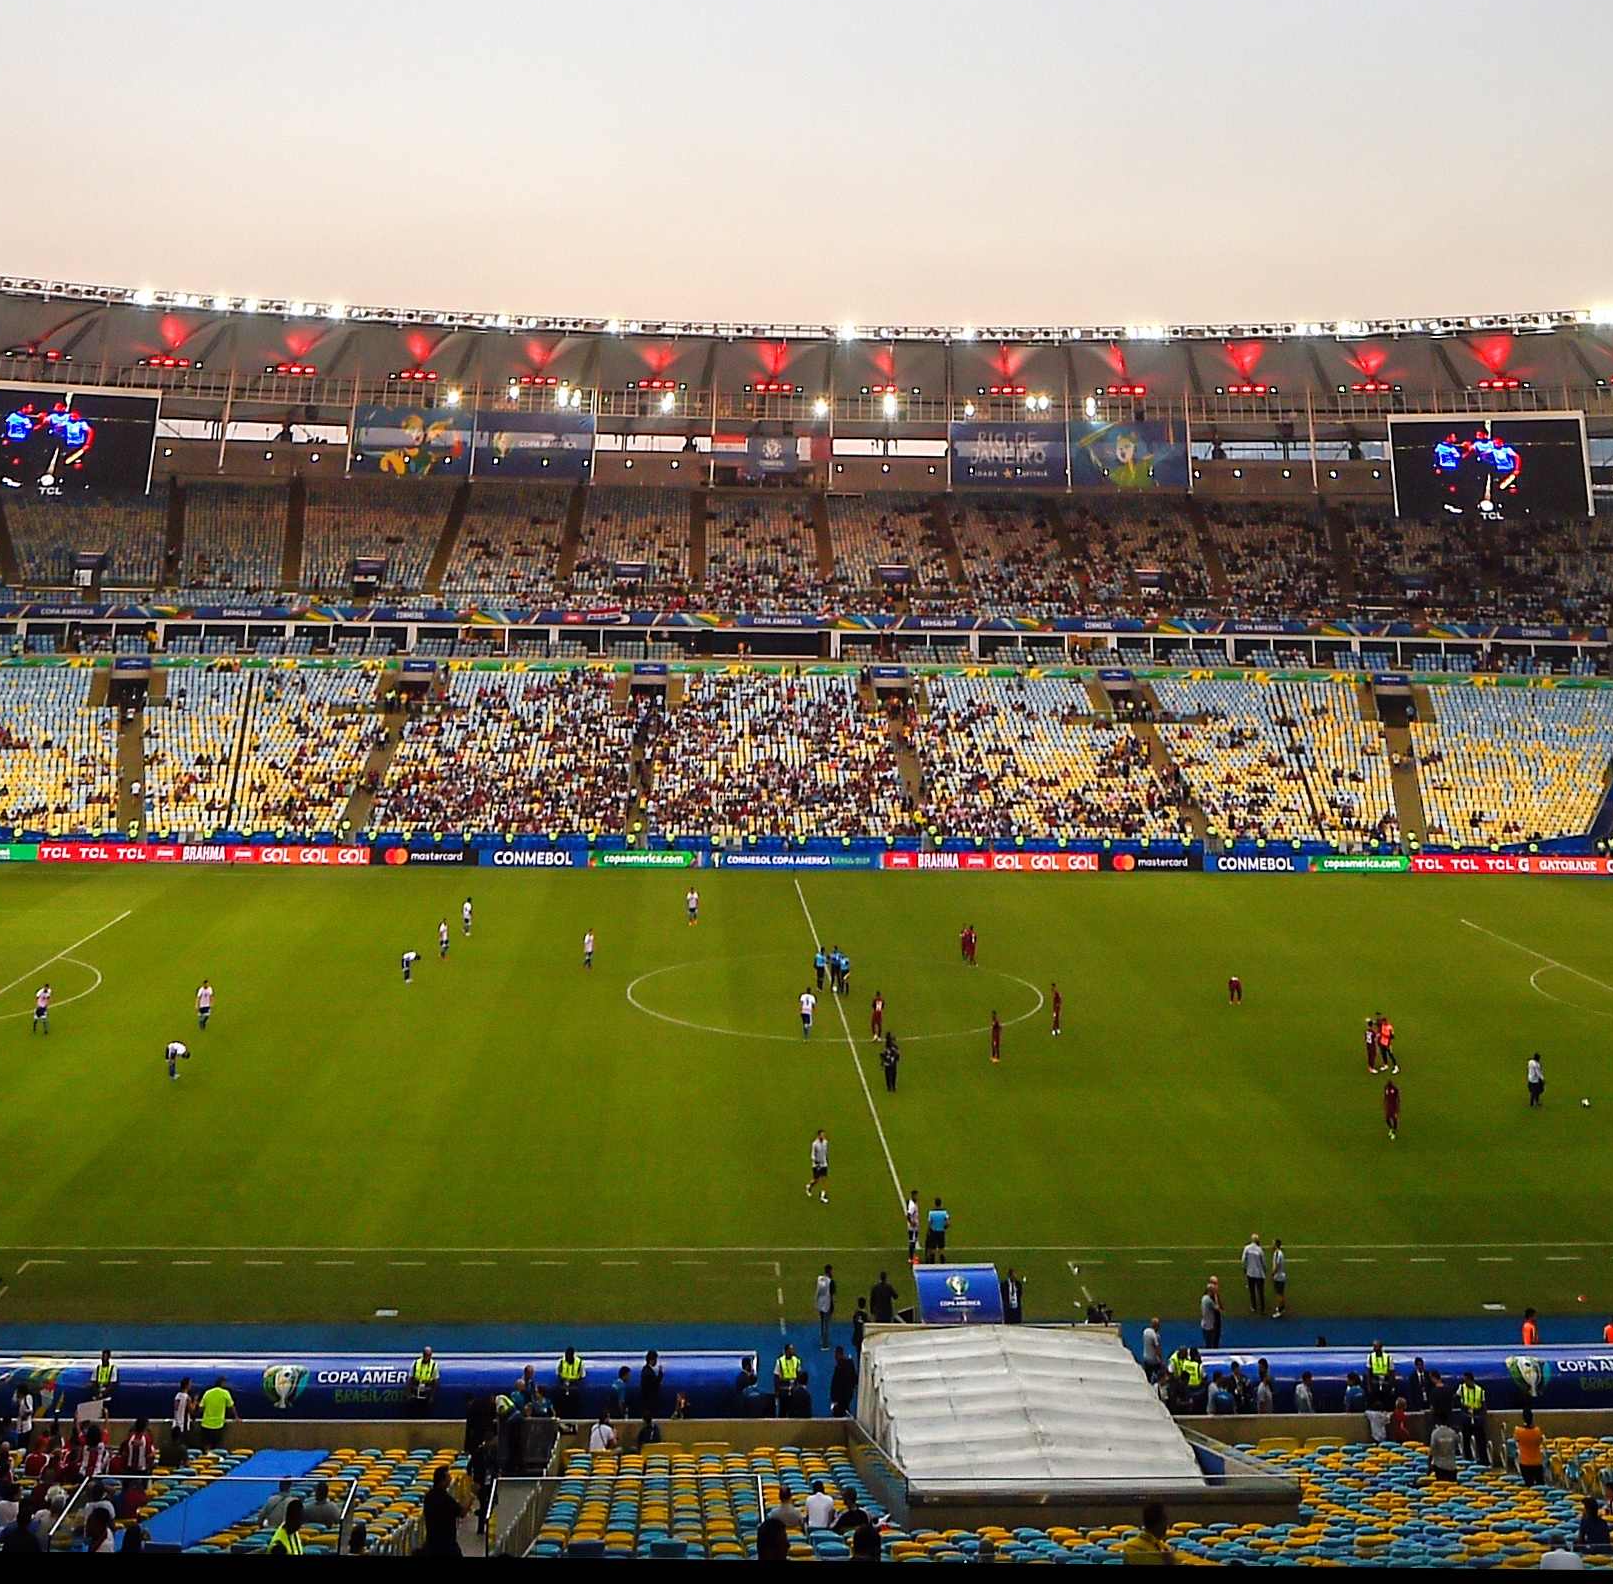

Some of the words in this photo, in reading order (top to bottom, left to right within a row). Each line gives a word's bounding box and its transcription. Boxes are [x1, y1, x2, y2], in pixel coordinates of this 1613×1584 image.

[39, 487, 62, 495] TCL
[1480, 512, 1504, 520] TCL
[41, 847, 70, 859] TCL
[78, 847, 108, 859] TCL
[117, 847, 146, 859] TCL
[182, 846, 226, 861] BRAHMA
[261, 848, 290, 863] GOL
[299, 848, 329, 863] GOL
[337, 848, 368, 863] GOL
[410, 850, 463, 862] mastercard
[493, 851, 573, 866] CONMEBOL
[603, 853, 684, 866] copaamerica.com
[726, 855, 771, 865] CONMEBOL
[772, 855, 794, 865] COPA
[794, 855, 831, 865] AMERICA
[918, 853, 959, 868] BRAHMA
[993, 854, 1023, 869] GOL
[1030, 854, 1059, 869] GOL
[1067, 854, 1096, 869] GOL
[1138, 857, 1188, 867] mastercard
[1217, 857, 1295, 871] CONMEBOL
[1323, 857, 1401, 871] copaamerica.com
[1415, 859, 1444, 871] TCL
[1450, 859, 1479, 871] TCL
[1487, 859, 1514, 871] TCL
[1518, 857, 1529, 871] G
[1539, 860, 1597, 871] GATORADE
[1557, 1360, 1599, 1372] COPA
[317, 1371, 359, 1384] COPA
[361, 1371, 408, 1384] AMER
